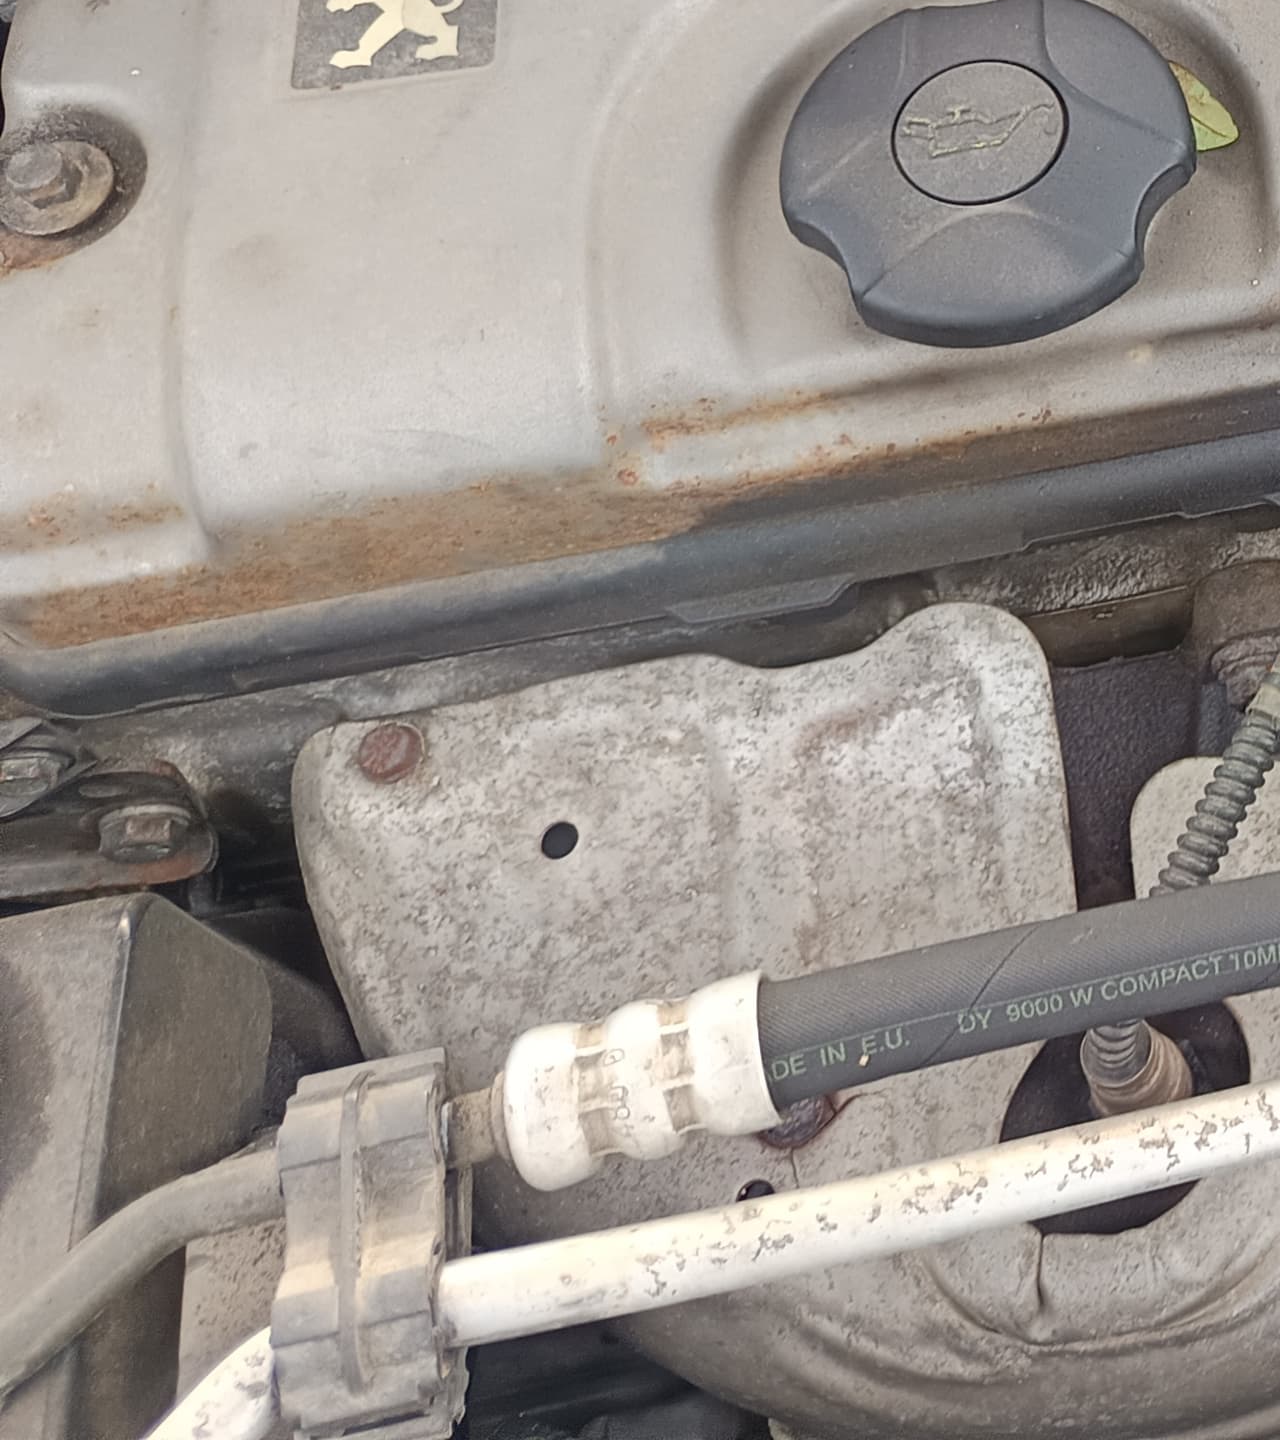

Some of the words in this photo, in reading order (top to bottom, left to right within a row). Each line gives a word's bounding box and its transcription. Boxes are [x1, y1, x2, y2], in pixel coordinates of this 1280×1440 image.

[820, 1042, 847, 1068] IN
[860, 1028, 911, 1056] E.U.
[957, 1009, 993, 1035] DY
[1005, 994, 1064, 1023] 9000
[1069, 986, 1094, 1008] W
[1100, 955, 1224, 1001] COMPACT
